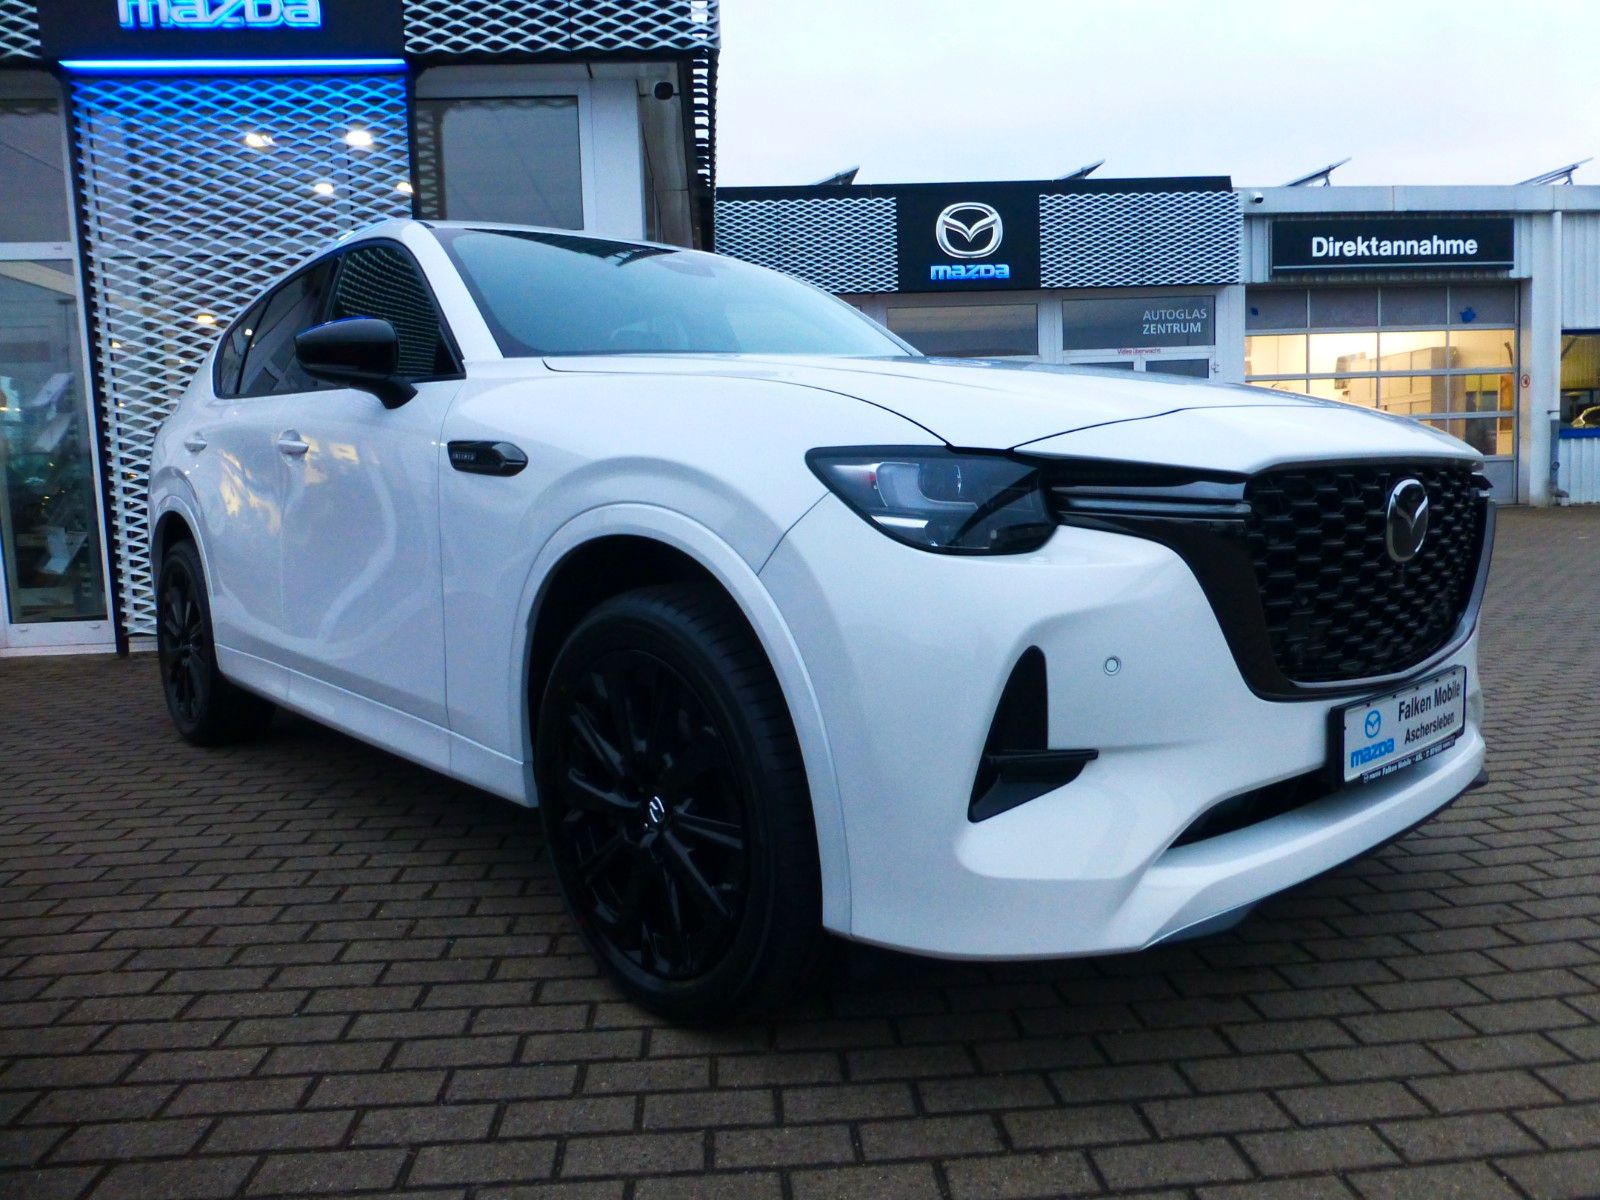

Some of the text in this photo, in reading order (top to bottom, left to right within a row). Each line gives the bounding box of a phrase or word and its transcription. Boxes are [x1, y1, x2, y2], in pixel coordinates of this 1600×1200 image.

[117, 0, 322, 28] mazda
[1311, 235, 1478, 257] Direktannahme
[930, 263, 1010, 280] mazda
[1142, 309, 1207, 321] AUTOGLAS
[1142, 322, 1202, 335] ZENTRUM
[1398, 682, 1460, 722] Falken Mobile
[1404, 711, 1455, 744] Aschersleben
[1350, 738, 1394, 768] mazda
